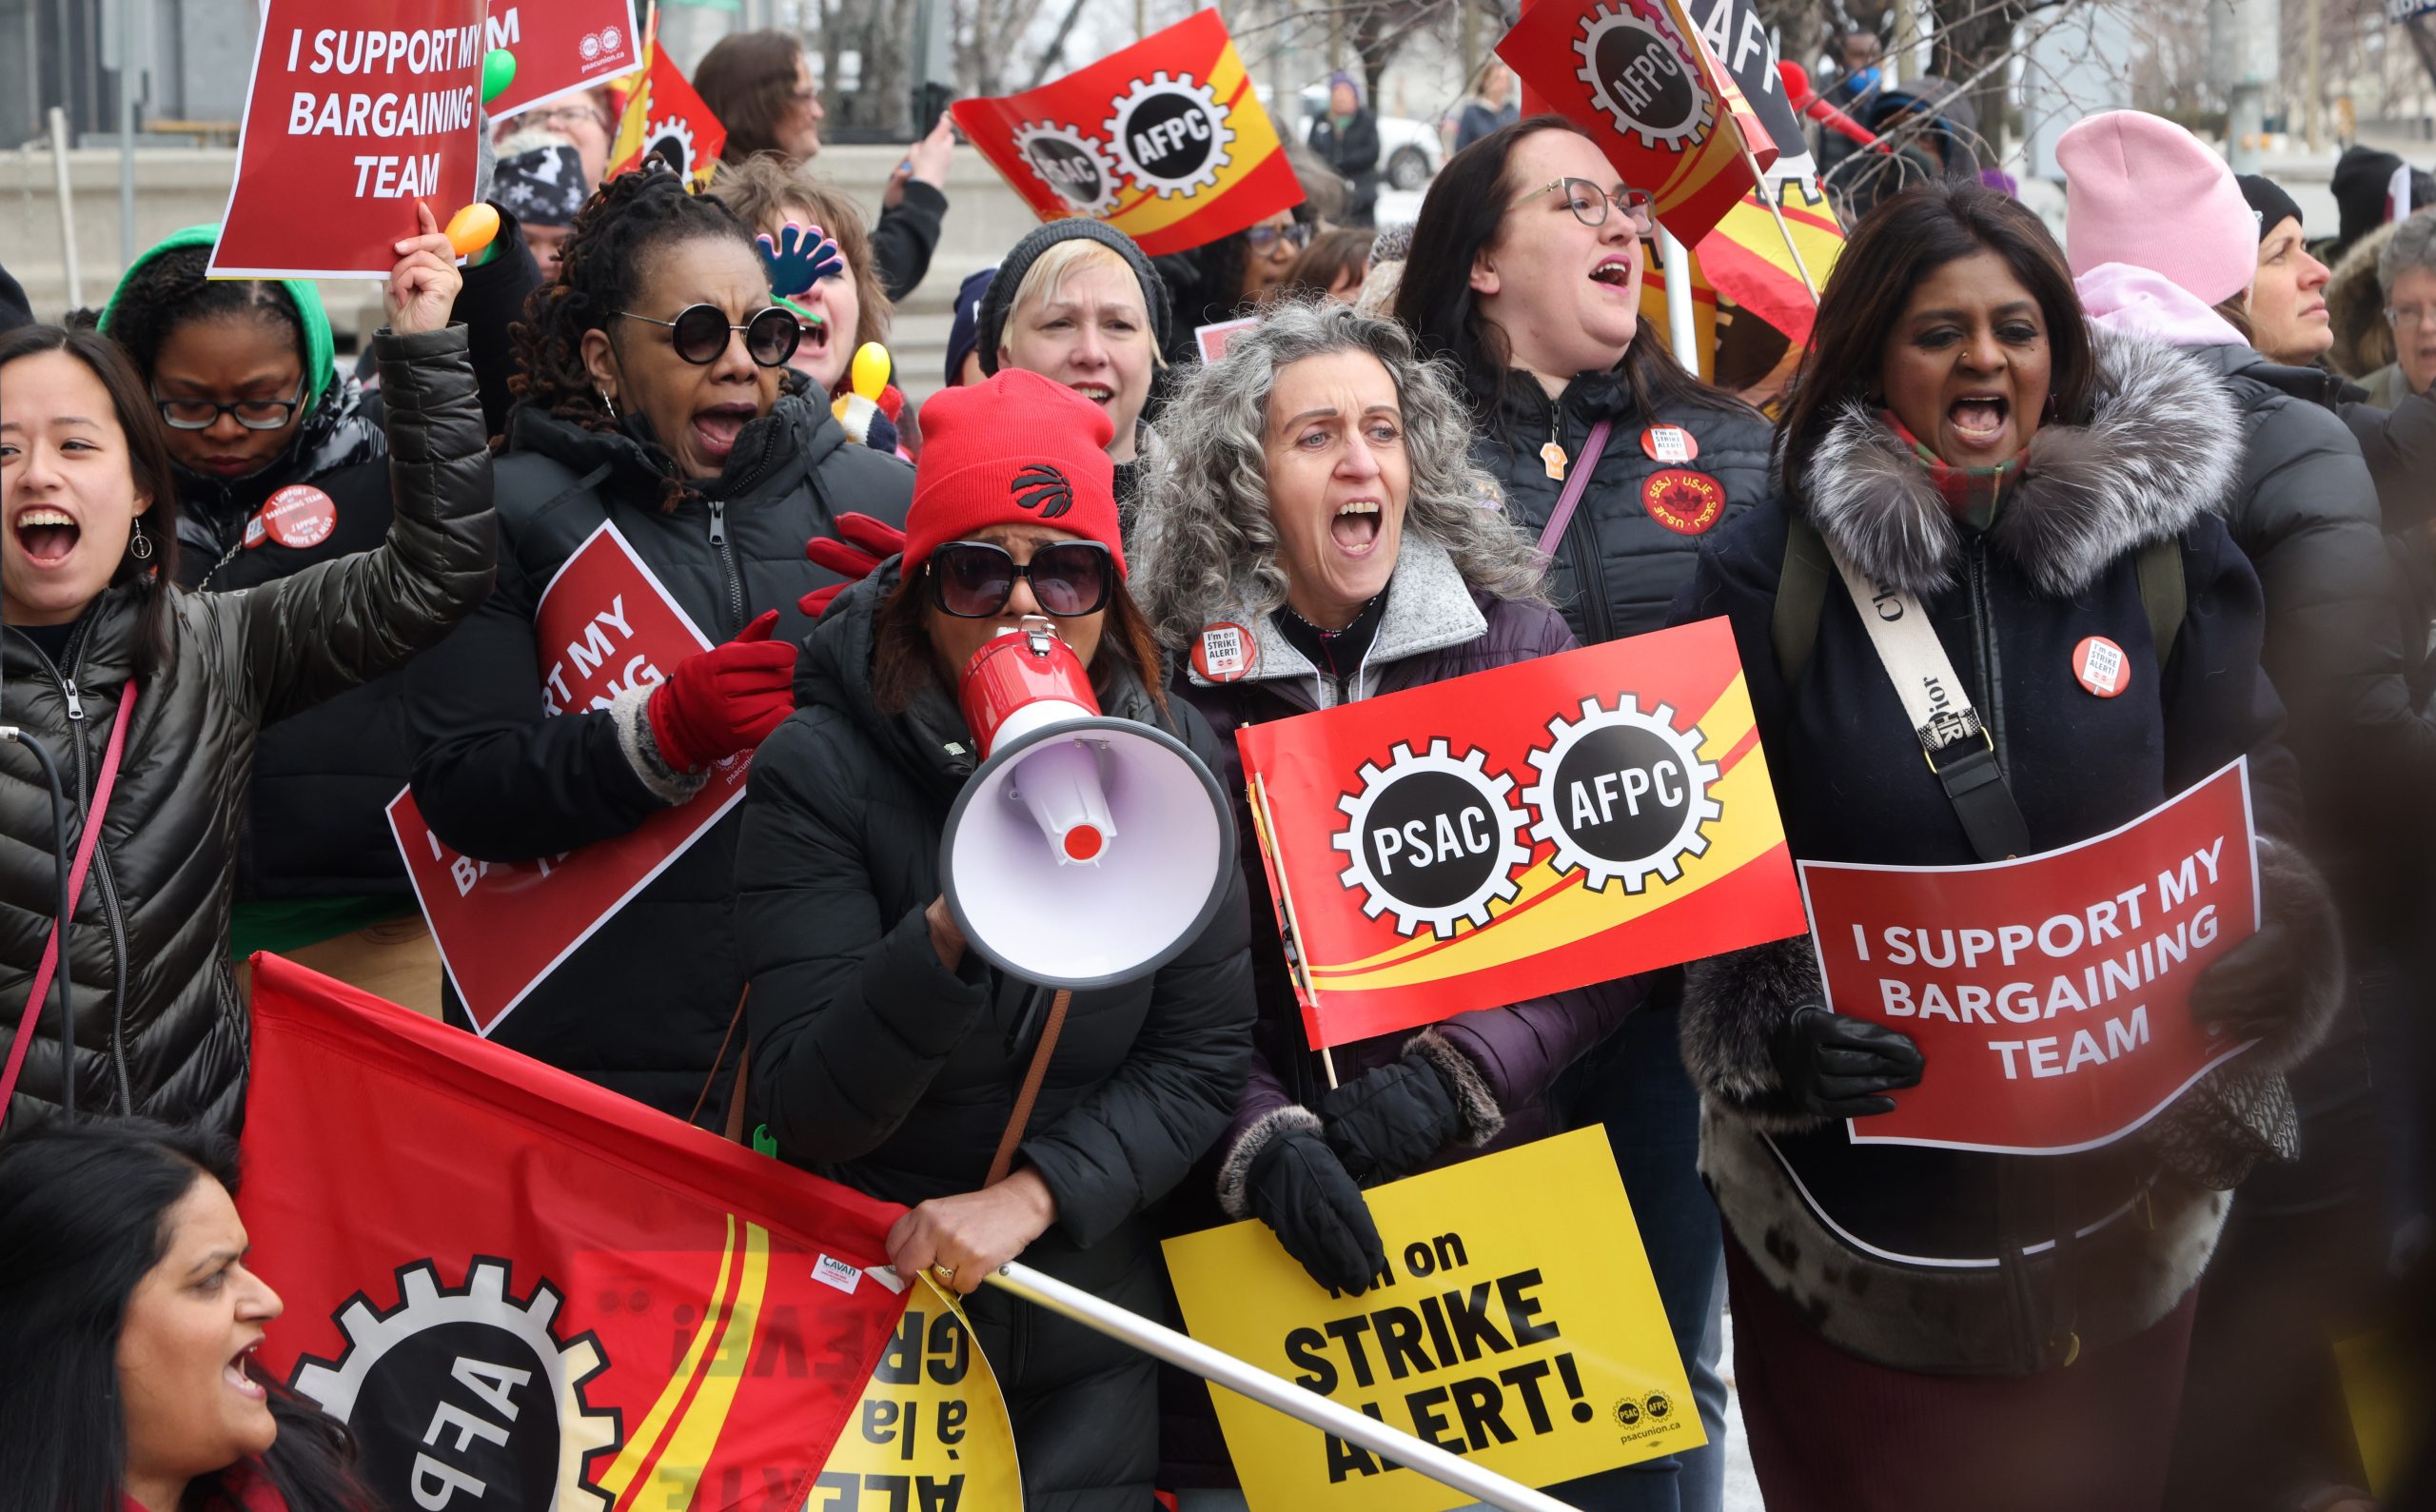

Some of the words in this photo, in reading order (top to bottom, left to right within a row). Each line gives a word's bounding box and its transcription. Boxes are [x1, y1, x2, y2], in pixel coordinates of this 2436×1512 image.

[287, 29, 303, 72] I
[309, 28, 458, 74] SUPPORT
[458, 23, 481, 69] MY
[581, 51, 625, 74] psacunion.ca
[1701, 0, 1782, 94] AFP
[1614, 43, 1678, 115] AFPC
[288, 85, 473, 137] BARGAINING
[1133, 108, 1210, 166] AFPC
[354, 152, 441, 198] TEAM
[1649, 476, 1671, 498] SESJ
[1682, 476, 1713, 495] USJE
[1654, 505, 1684, 528] USJE
[1694, 501, 1717, 527] SESJ
[566, 594, 635, 679] MY
[1208, 639, 1237, 650] STRIKE
[1209, 648, 1238, 658] ALERT!
[2092, 651, 2117, 668] STRIKE
[2094, 643, 2106, 654] I'm
[2090, 659, 2114, 676] ALERT!
[726, 755, 754, 785] psacuni
[1372, 805, 1492, 876] PSAC
[1569, 758, 1683, 831] AFPC
[1852, 924, 1871, 961] I
[1883, 883, 2148, 969] SUPPORT
[2157, 835, 2225, 913] MY
[1879, 904, 2219, 1024] BARGAINING
[1988, 1004, 2151, 1080] TEAM
[1404, 1232, 1469, 1278] on
[1284, 1267, 1562, 1397] STRIKE
[862, 1400, 917, 1461] la
[936, 1400, 968, 1460] à
[1619, 1408, 1639, 1421] PSAC
[1648, 1401, 1667, 1413] AFPC
[1621, 1422, 1681, 1445] psacunion.ca
